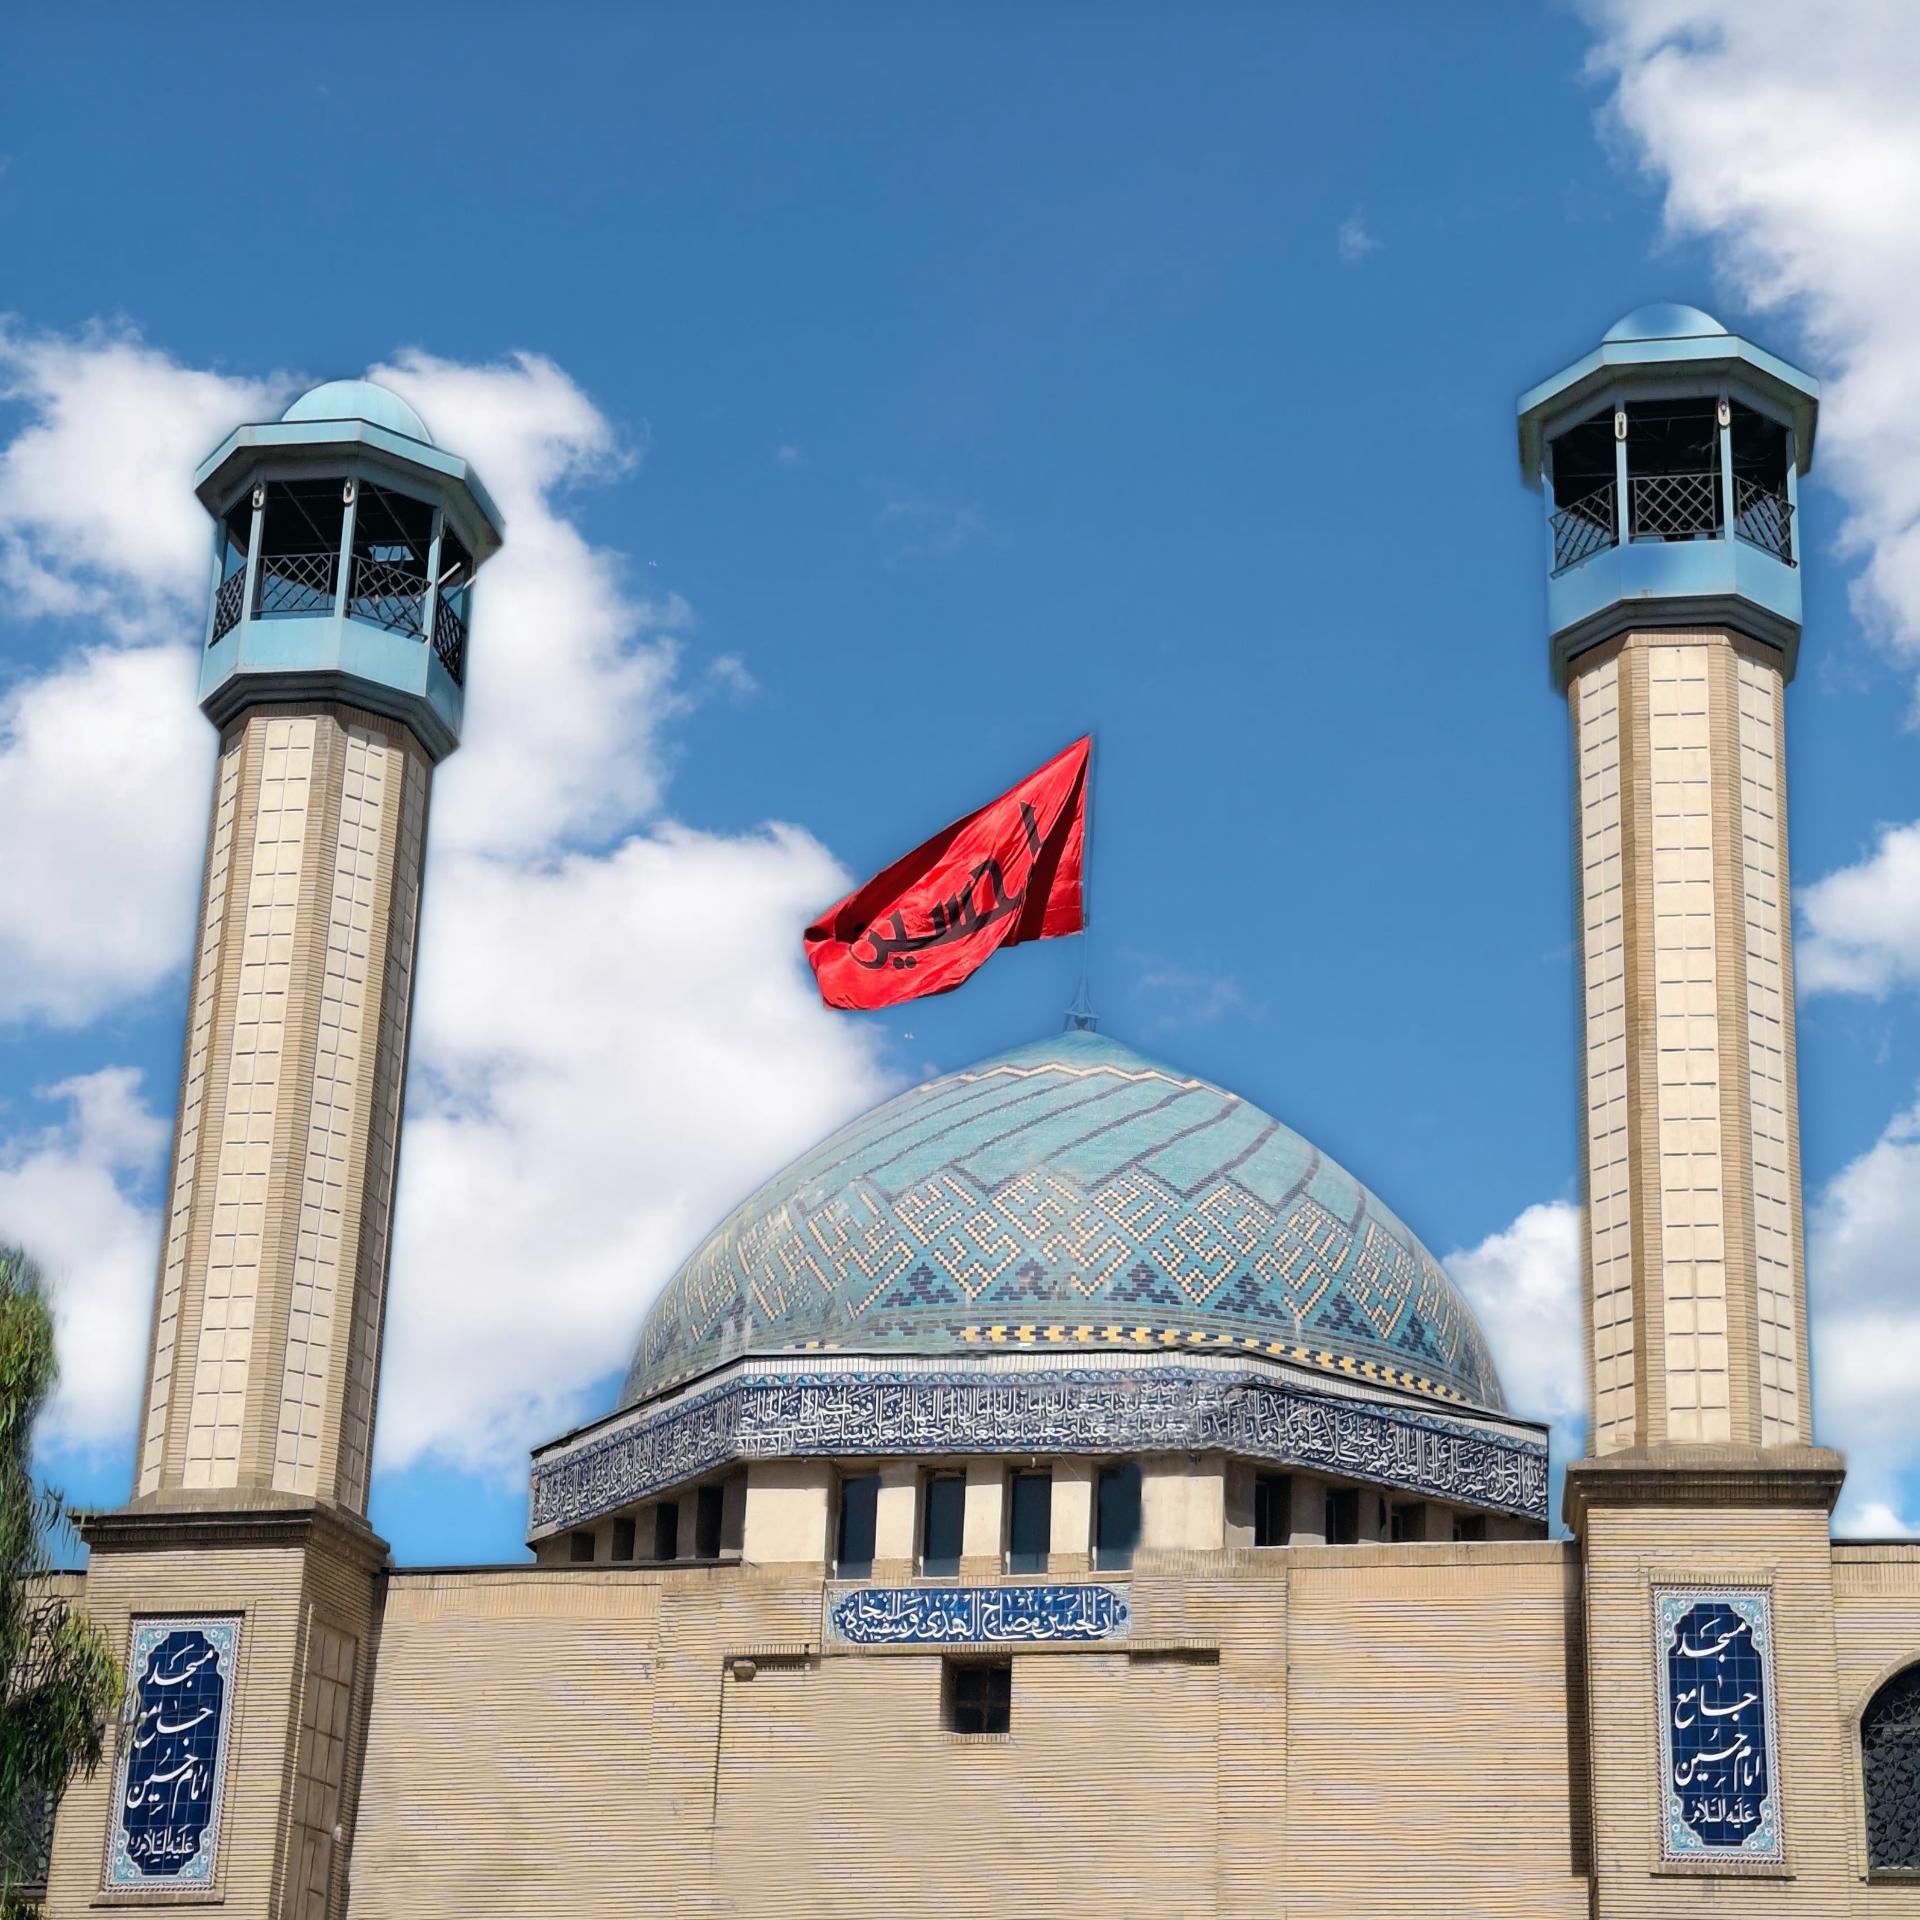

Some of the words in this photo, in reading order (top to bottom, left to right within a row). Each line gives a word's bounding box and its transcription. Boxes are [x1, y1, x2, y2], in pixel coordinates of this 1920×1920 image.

[147, 1644, 214, 1687] مسجد
[1676, 1619, 1747, 1663] مسجد
[1674, 1677, 1758, 1730] جامع
[127, 1752, 199, 1809] حسين
[1674, 1731, 1749, 1787] حسين
[1733, 1743, 1760, 1792] امام
[171, 1764, 209, 1819] امام
